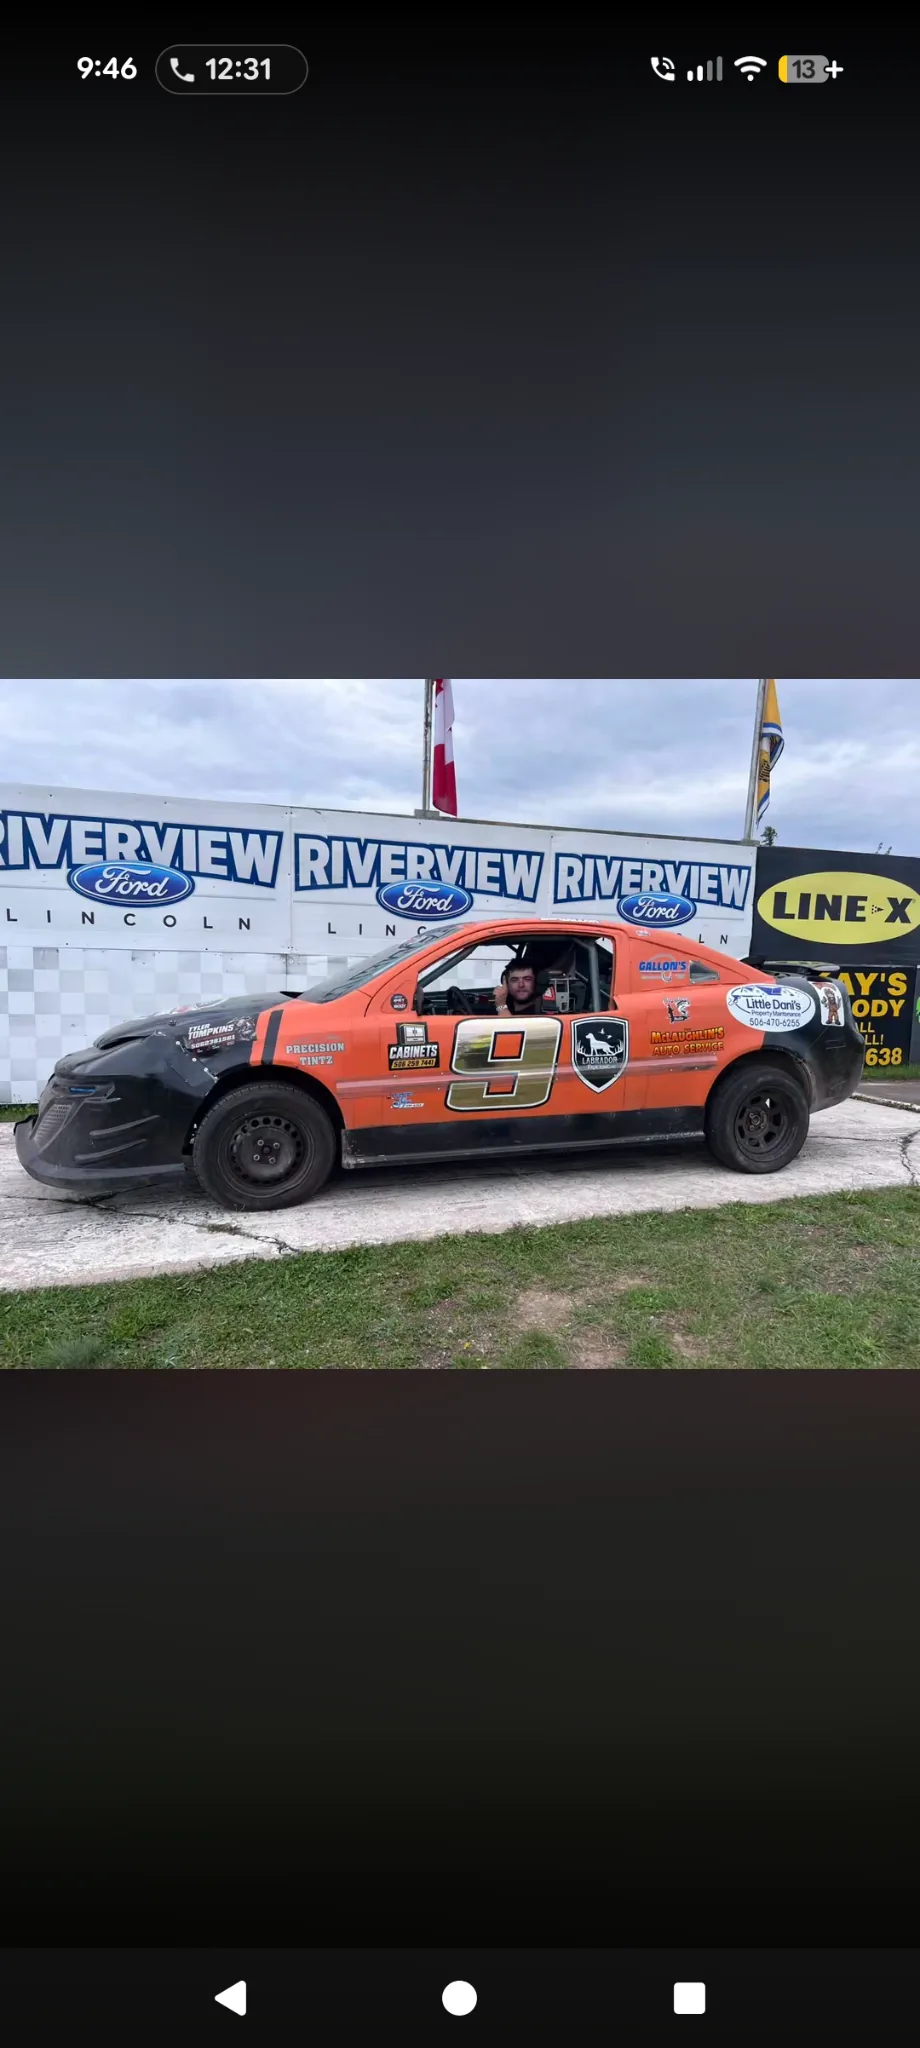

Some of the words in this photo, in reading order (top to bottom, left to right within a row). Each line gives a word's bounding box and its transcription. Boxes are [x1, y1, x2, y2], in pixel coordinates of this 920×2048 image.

[0, 812, 281, 887] IVERVIEW
[297, 835, 543, 900] RIVERVIEW
[95, 866, 168, 897] Ford
[556, 855, 750, 908] RIVERVIEW
[397, 884, 452, 912] Ford
[632, 897, 680, 920] Ford
[6, 908, 251, 930] LINCOLN
[328, 922, 427, 936] LINC
[639, 961, 686, 971] GALLON'S
[819, 972, 907, 996] AY'S
[746, 998, 771, 1009] Little
[773, 999, 801, 1011] Dani's
[852, 999, 905, 1017] ODY
[188, 1023, 211, 1033] TYLER
[749, 1018, 801, 1027] 506-470-6255
[188, 1024, 235, 1040] TOMPKINS
[865, 1034, 884, 1045] LL!
[286, 1042, 345, 1054] PRECISION
[389, 1044, 438, 1060] CABINETS
[652, 1045, 680, 1056] AUTO
[684, 1042, 724, 1055] SERVICE
[300, 1055, 333, 1066] TINTZ
[444, 1017, 563, 1112] 9
[582, 1056, 618, 1065] LABRADOR
[865, 1047, 902, 1066] 638
